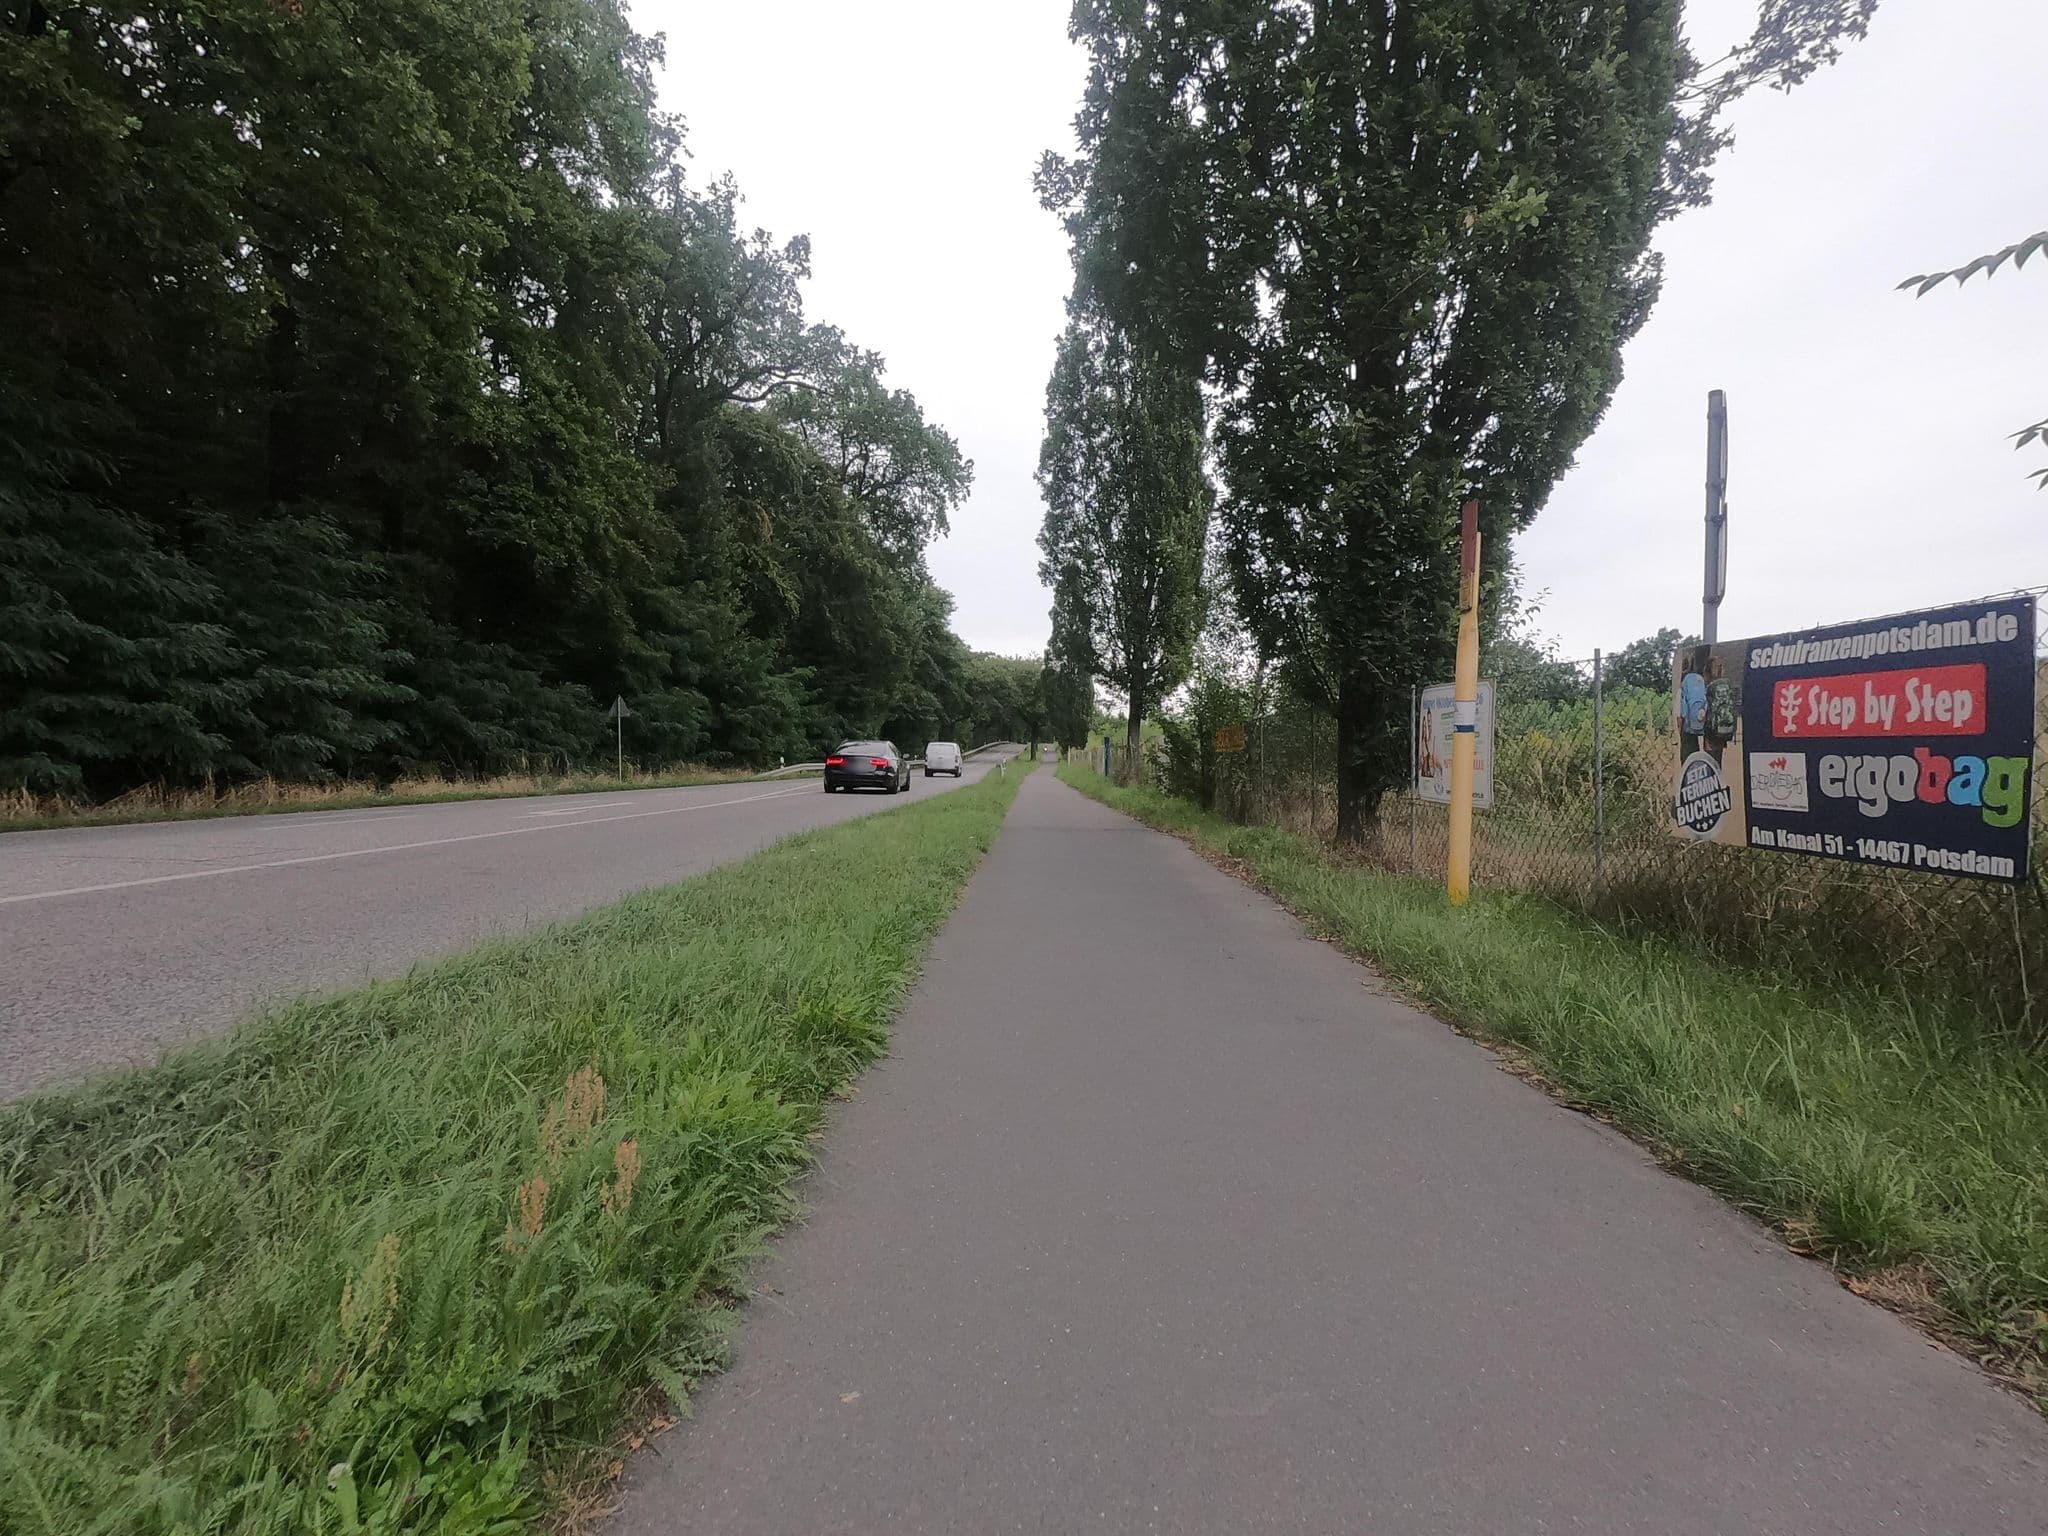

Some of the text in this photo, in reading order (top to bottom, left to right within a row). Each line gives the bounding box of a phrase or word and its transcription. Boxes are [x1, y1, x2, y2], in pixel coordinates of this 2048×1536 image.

[1750, 611, 2018, 668] schulranzenpotsdam.de
[1807, 677, 1973, 731] Step by Step
[1676, 790, 1730, 826] BUCHEN
[1681, 774, 1719, 803] TERMIN
[1818, 747, 2028, 828] ergobag
[1751, 826, 1775, 846] Am
[1776, 828, 1822, 852] Kanal
[1825, 834, 1844, 855] 51
[1856, 838, 1909, 864] 14467
[1914, 844, 2014, 877] Potsdam
